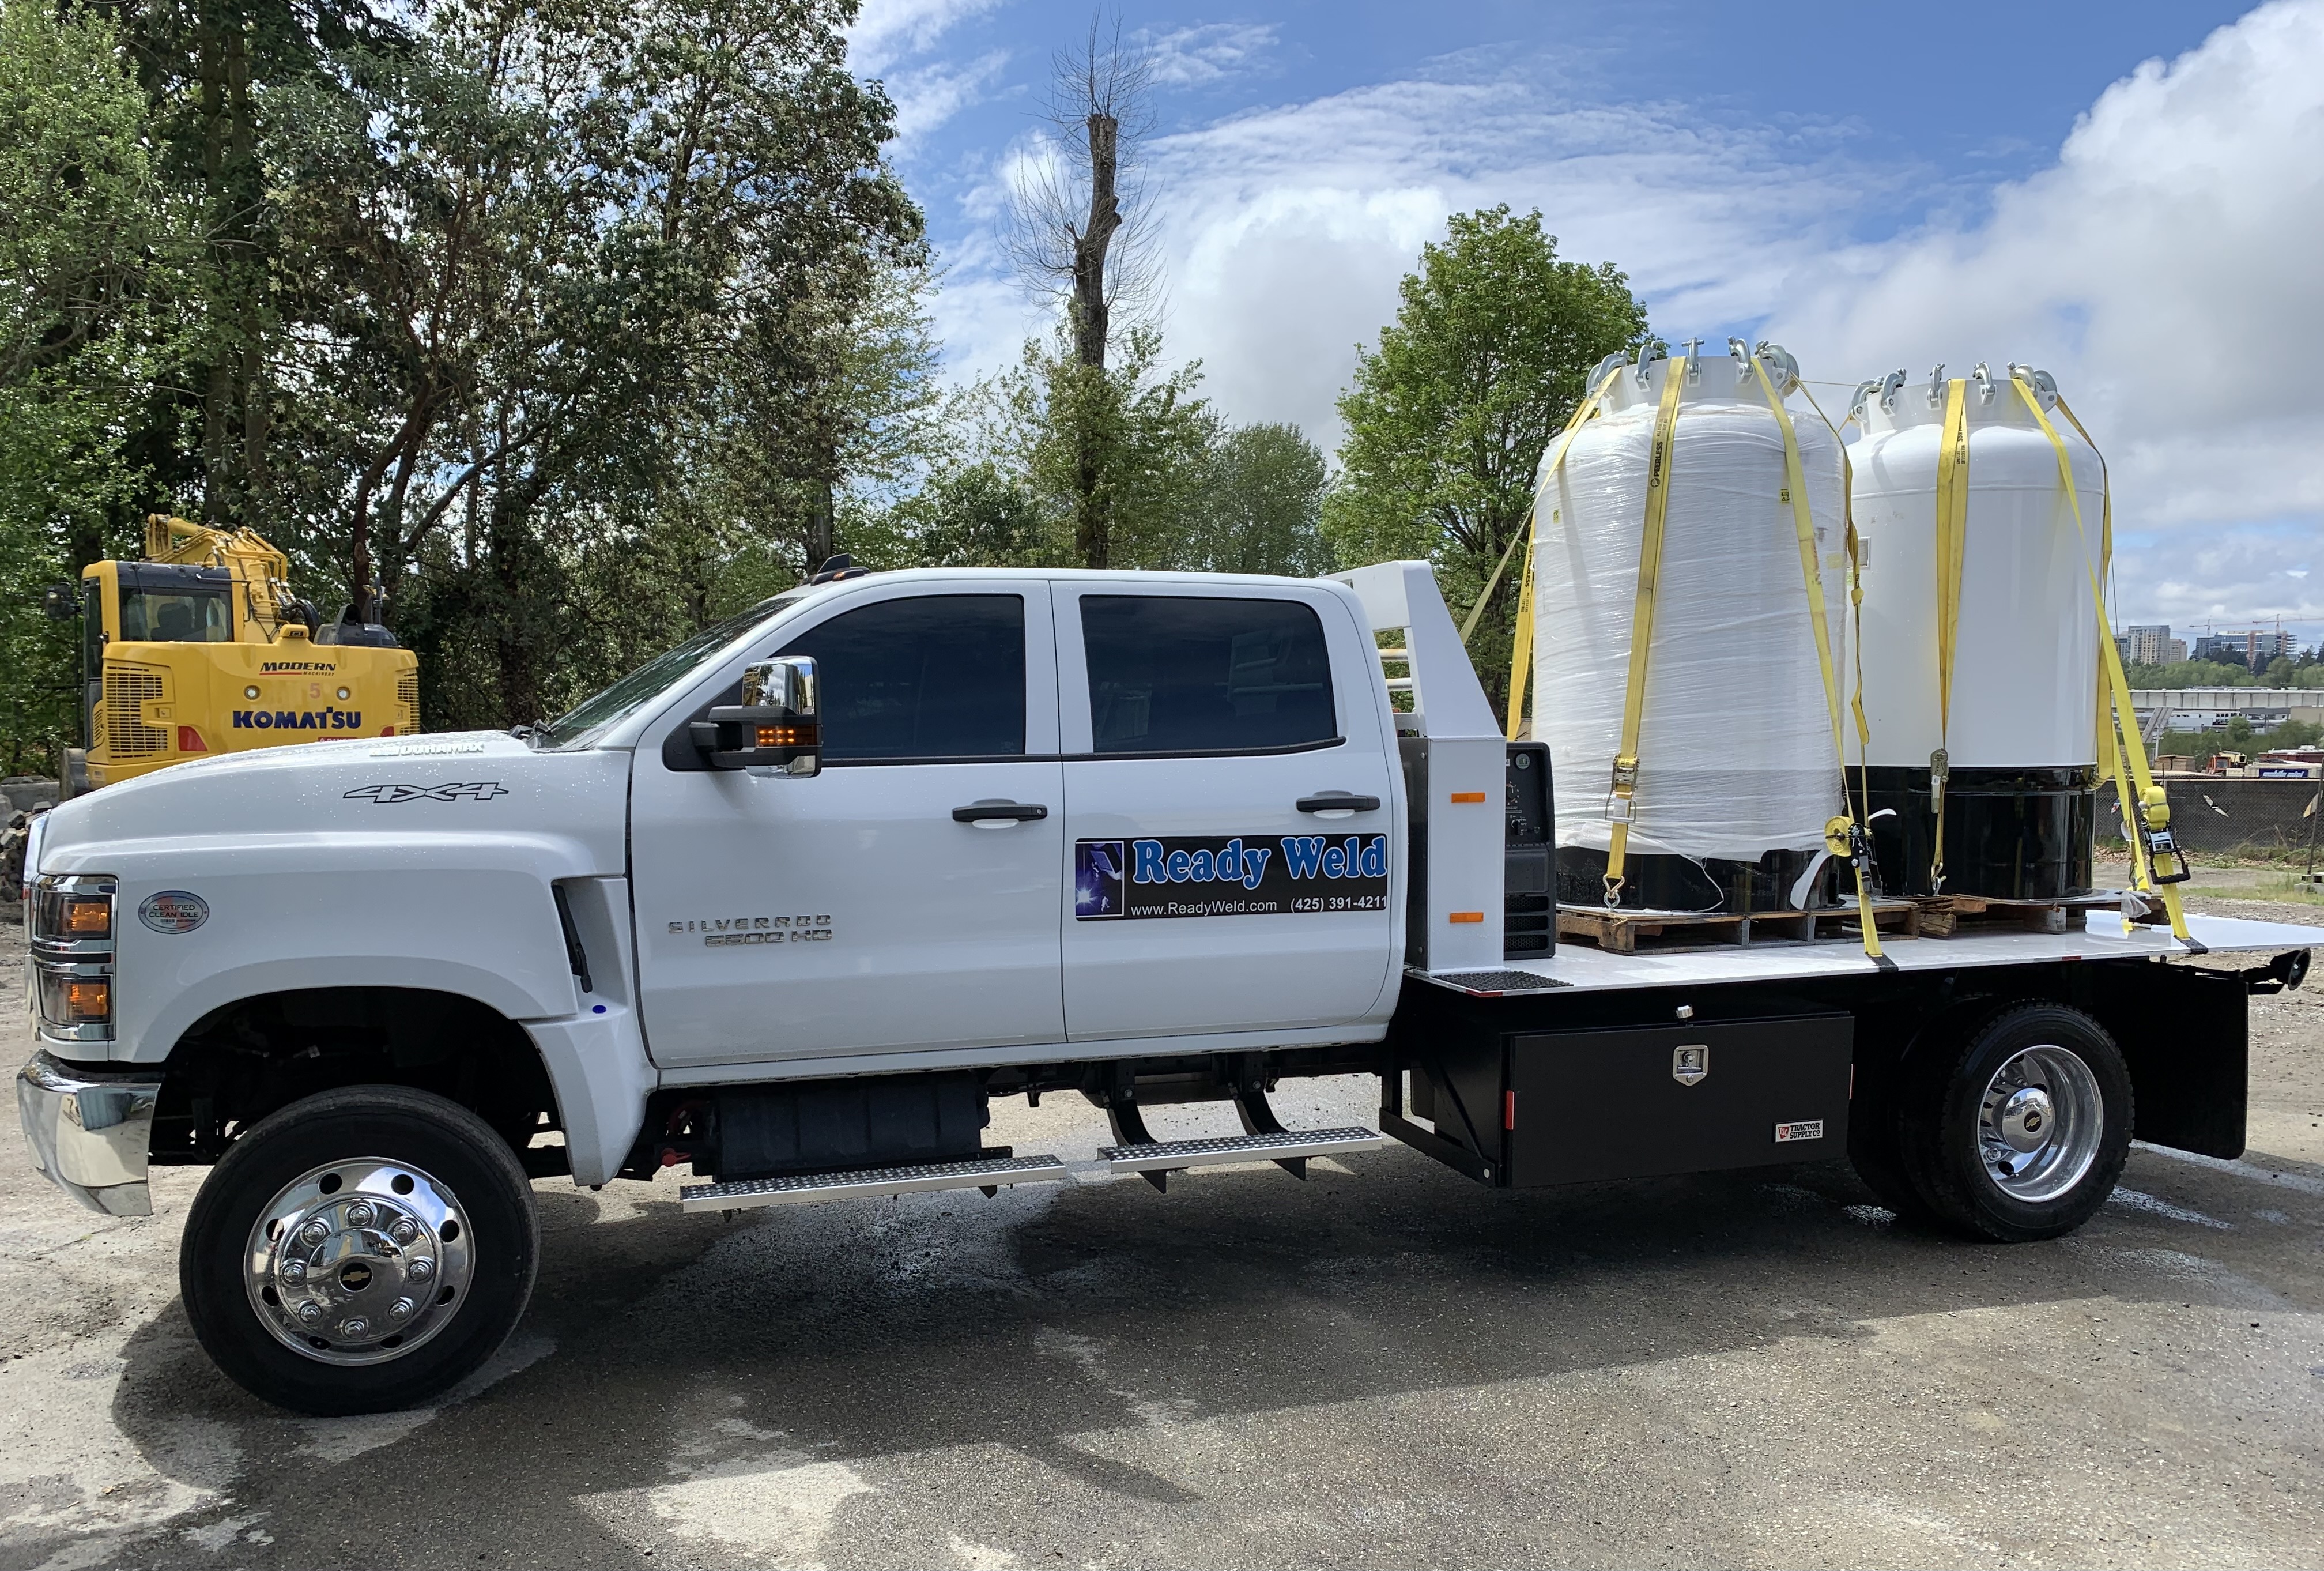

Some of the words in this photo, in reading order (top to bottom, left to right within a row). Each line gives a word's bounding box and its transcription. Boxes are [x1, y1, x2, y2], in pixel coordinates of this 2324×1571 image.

[1653, 441, 1663, 477] PEERLESS
[260, 662, 336, 672] MODERN
[310, 682, 320, 699] 5
[233, 706, 361, 729] KOMATSU
[1132, 838, 1272, 890] Ready
[1281, 835, 1388, 880] Weld
[1130, 899, 1278, 916] www.ReadyWeld.com
[1291, 897, 1324, 913] (425)
[1329, 895, 1387, 909] 391-4211
[669, 913, 831, 934] SILVERADO
[791, 929, 832, 942] HD
[1790, 1122, 1820, 1131] TRACTOR
[1790, 1131, 1812, 1139] SUPPLY
